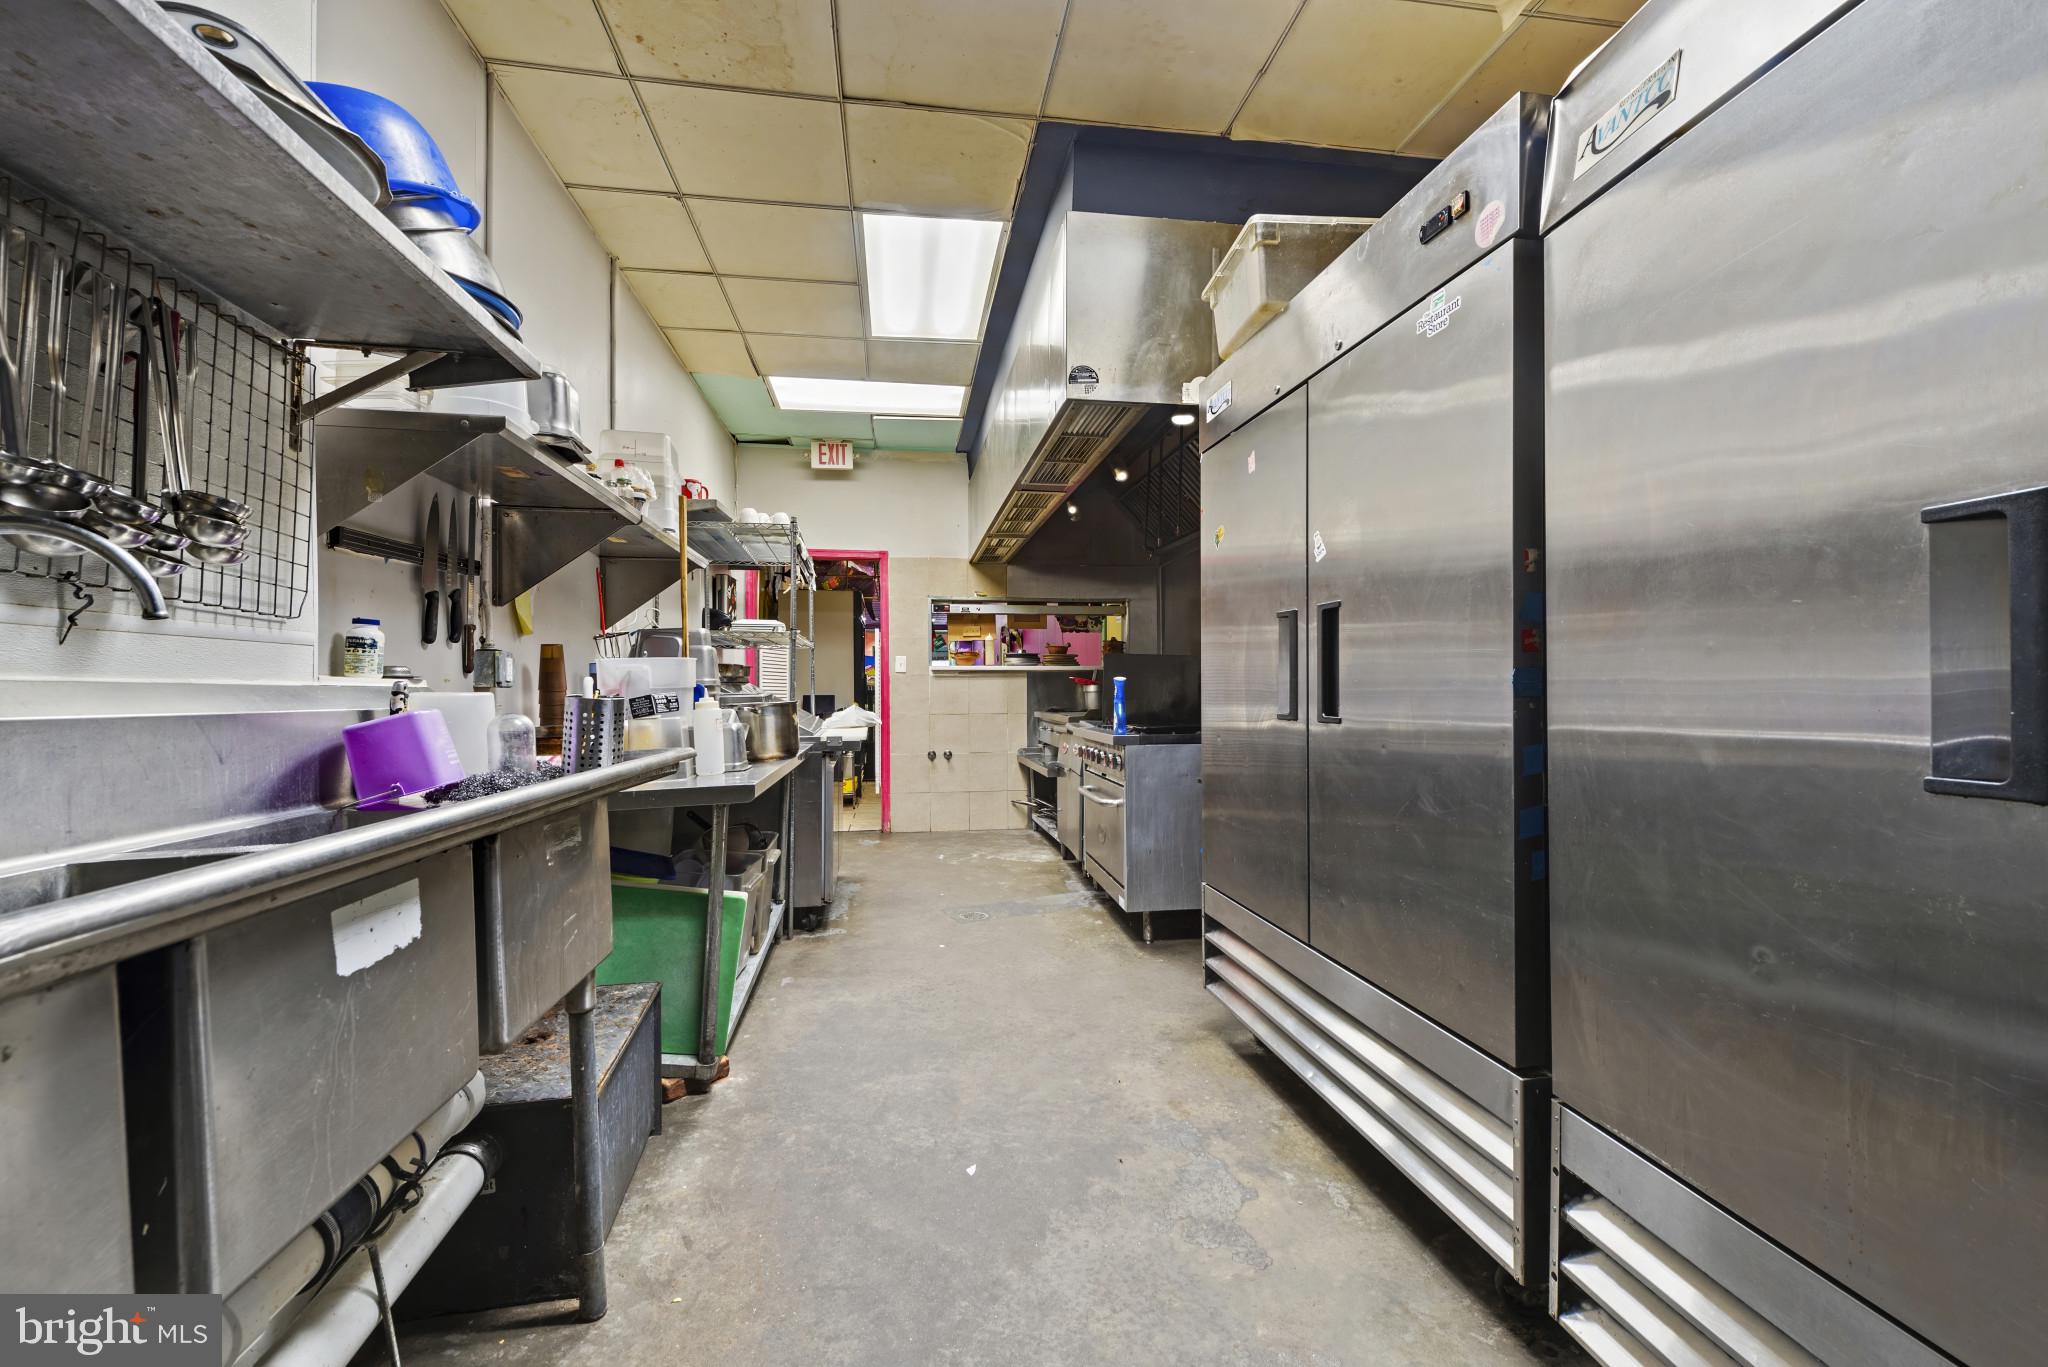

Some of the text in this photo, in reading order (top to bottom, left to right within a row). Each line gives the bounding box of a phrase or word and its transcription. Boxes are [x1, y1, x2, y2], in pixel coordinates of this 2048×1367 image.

[1417, 298, 1460, 332] Restaurant
[1427, 317, 1448, 336] Store
[818, 443, 848, 465] EXIT
